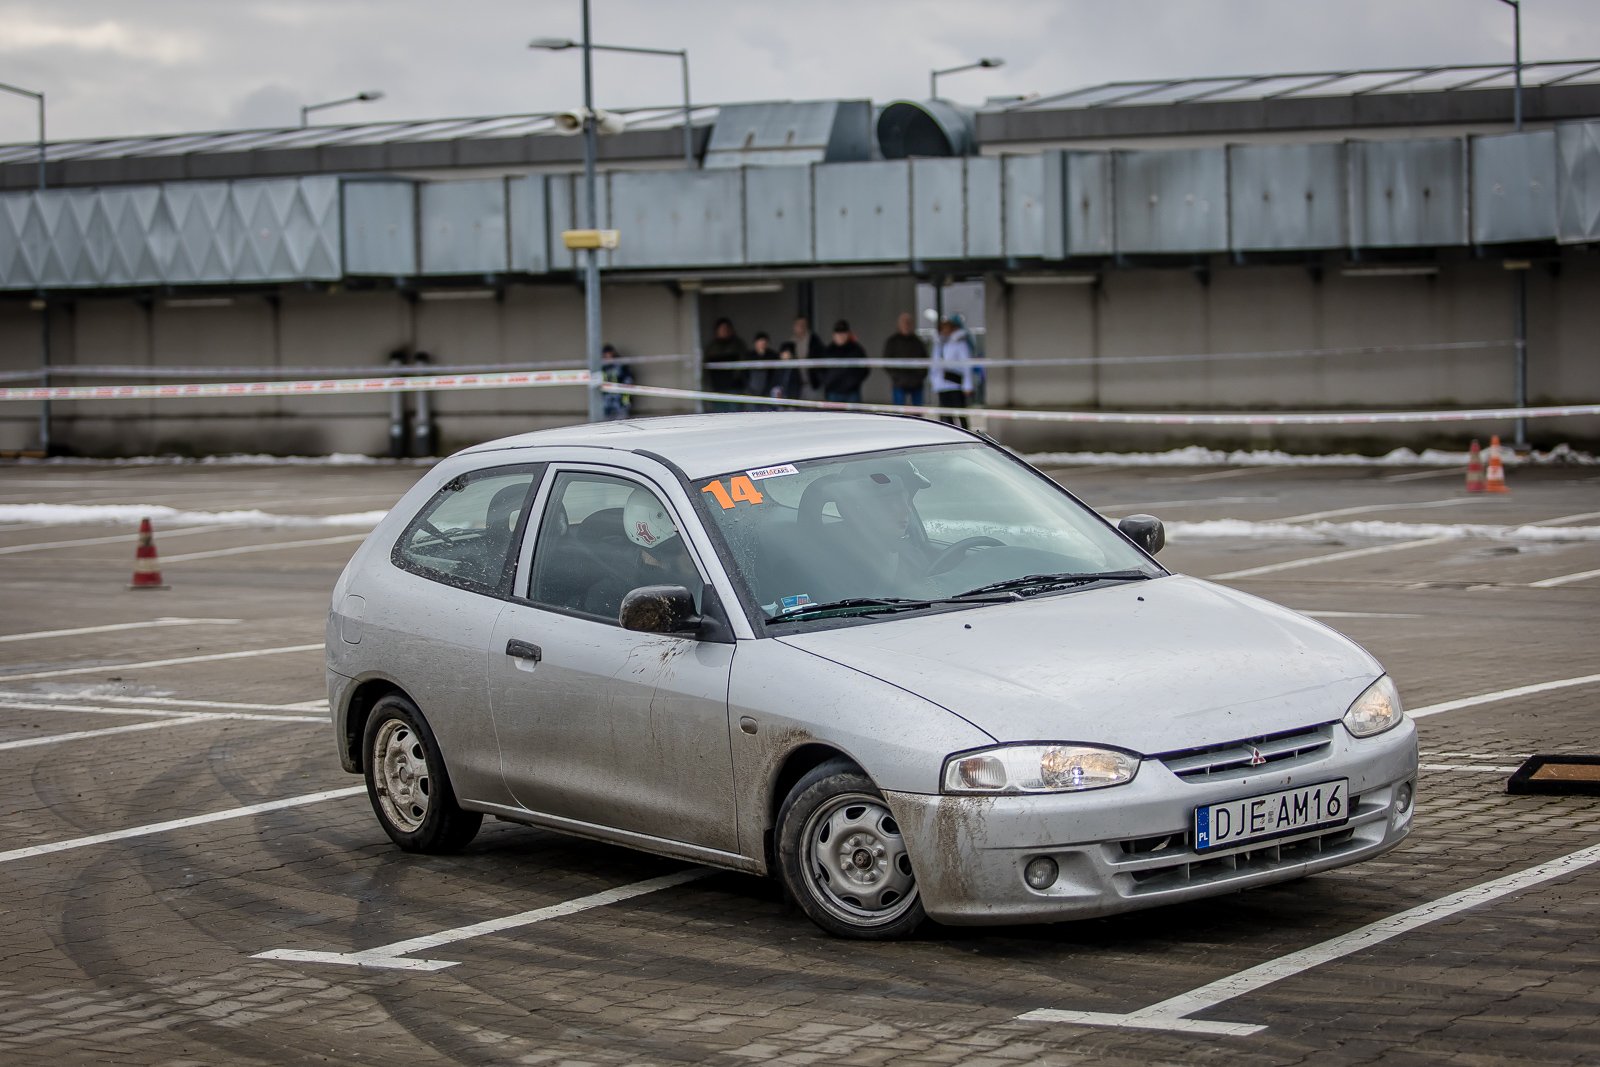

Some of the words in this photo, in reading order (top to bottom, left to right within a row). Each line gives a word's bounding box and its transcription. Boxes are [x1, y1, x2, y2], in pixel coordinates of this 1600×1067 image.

[702, 476, 763, 509] 14
[1216, 800, 1266, 840] DJE
[1276, 785, 1340, 828] AM16
[1199, 832, 1208, 841] PL
